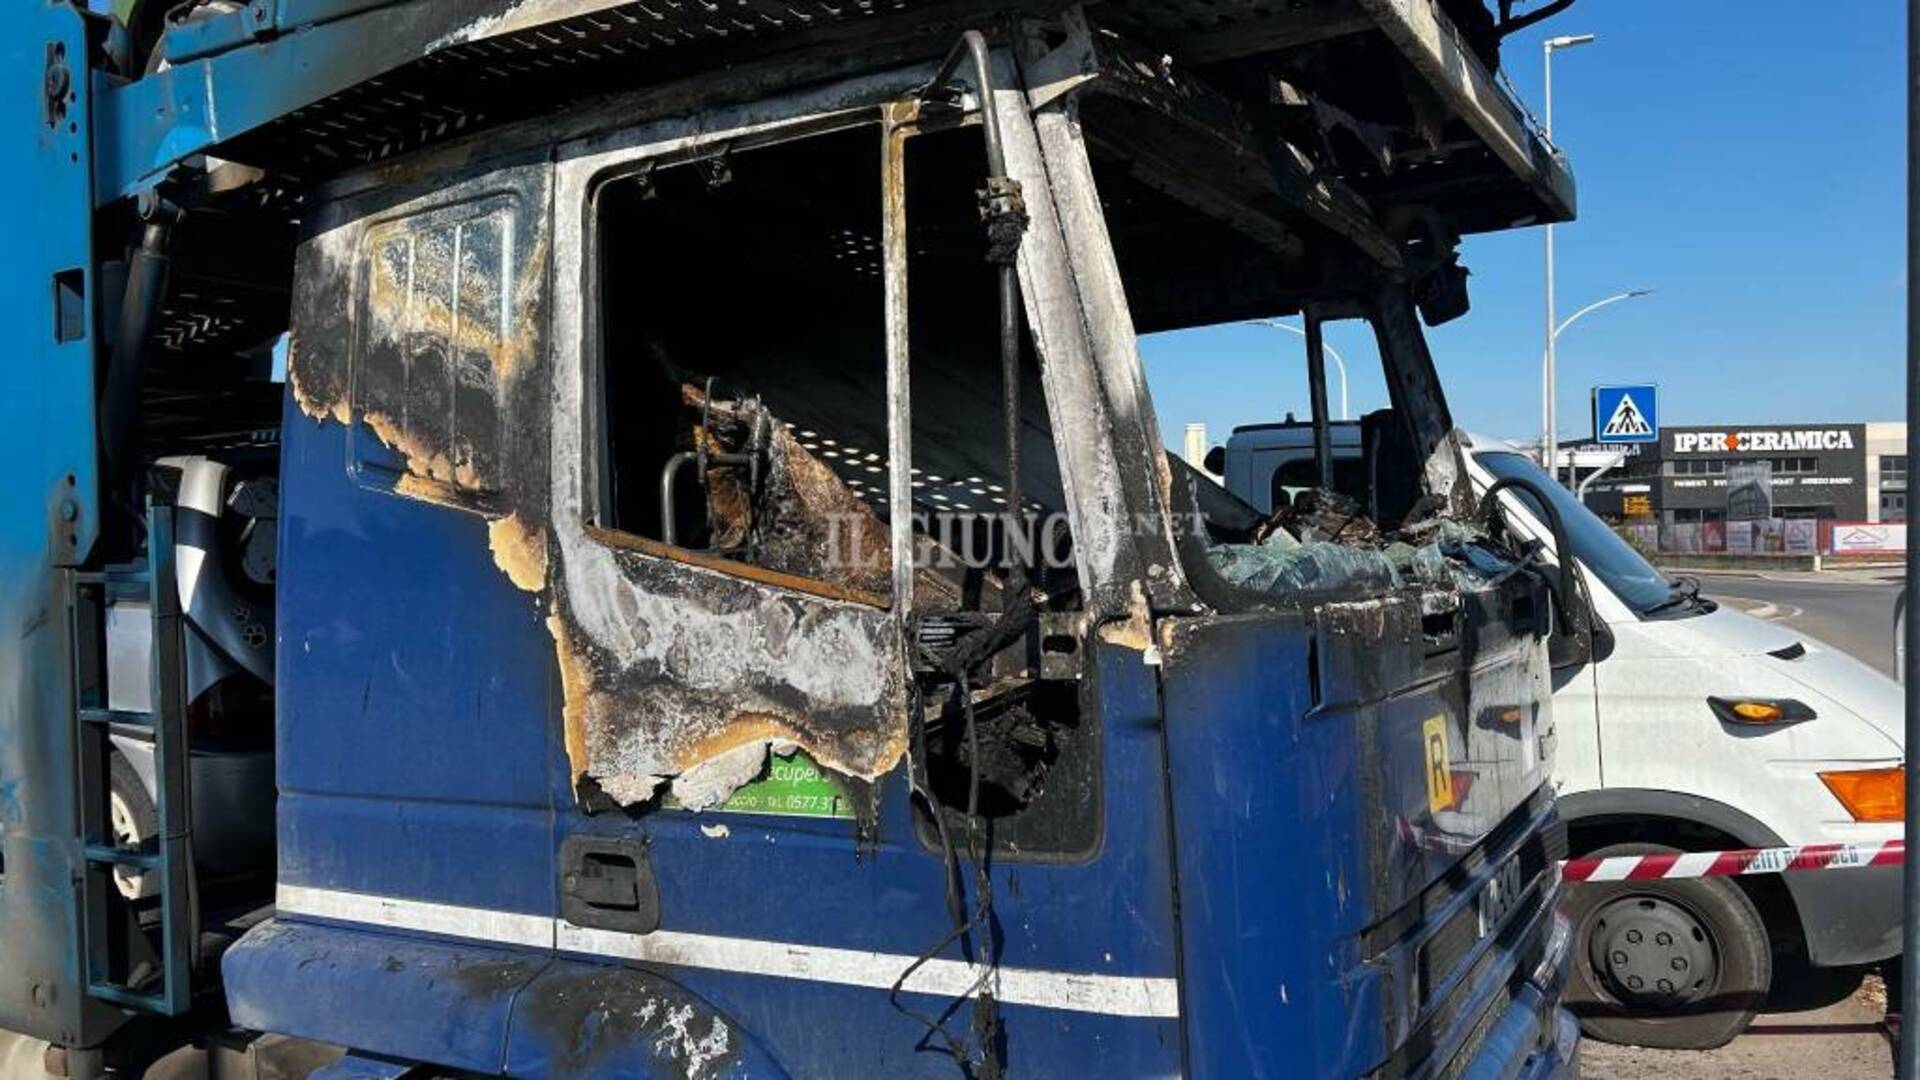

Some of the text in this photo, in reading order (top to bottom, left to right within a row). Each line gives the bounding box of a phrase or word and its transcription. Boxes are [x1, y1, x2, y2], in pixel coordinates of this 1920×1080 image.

[1674, 431, 1853, 452] IPER CERAMICA
[1429, 732, 1448, 799] R
